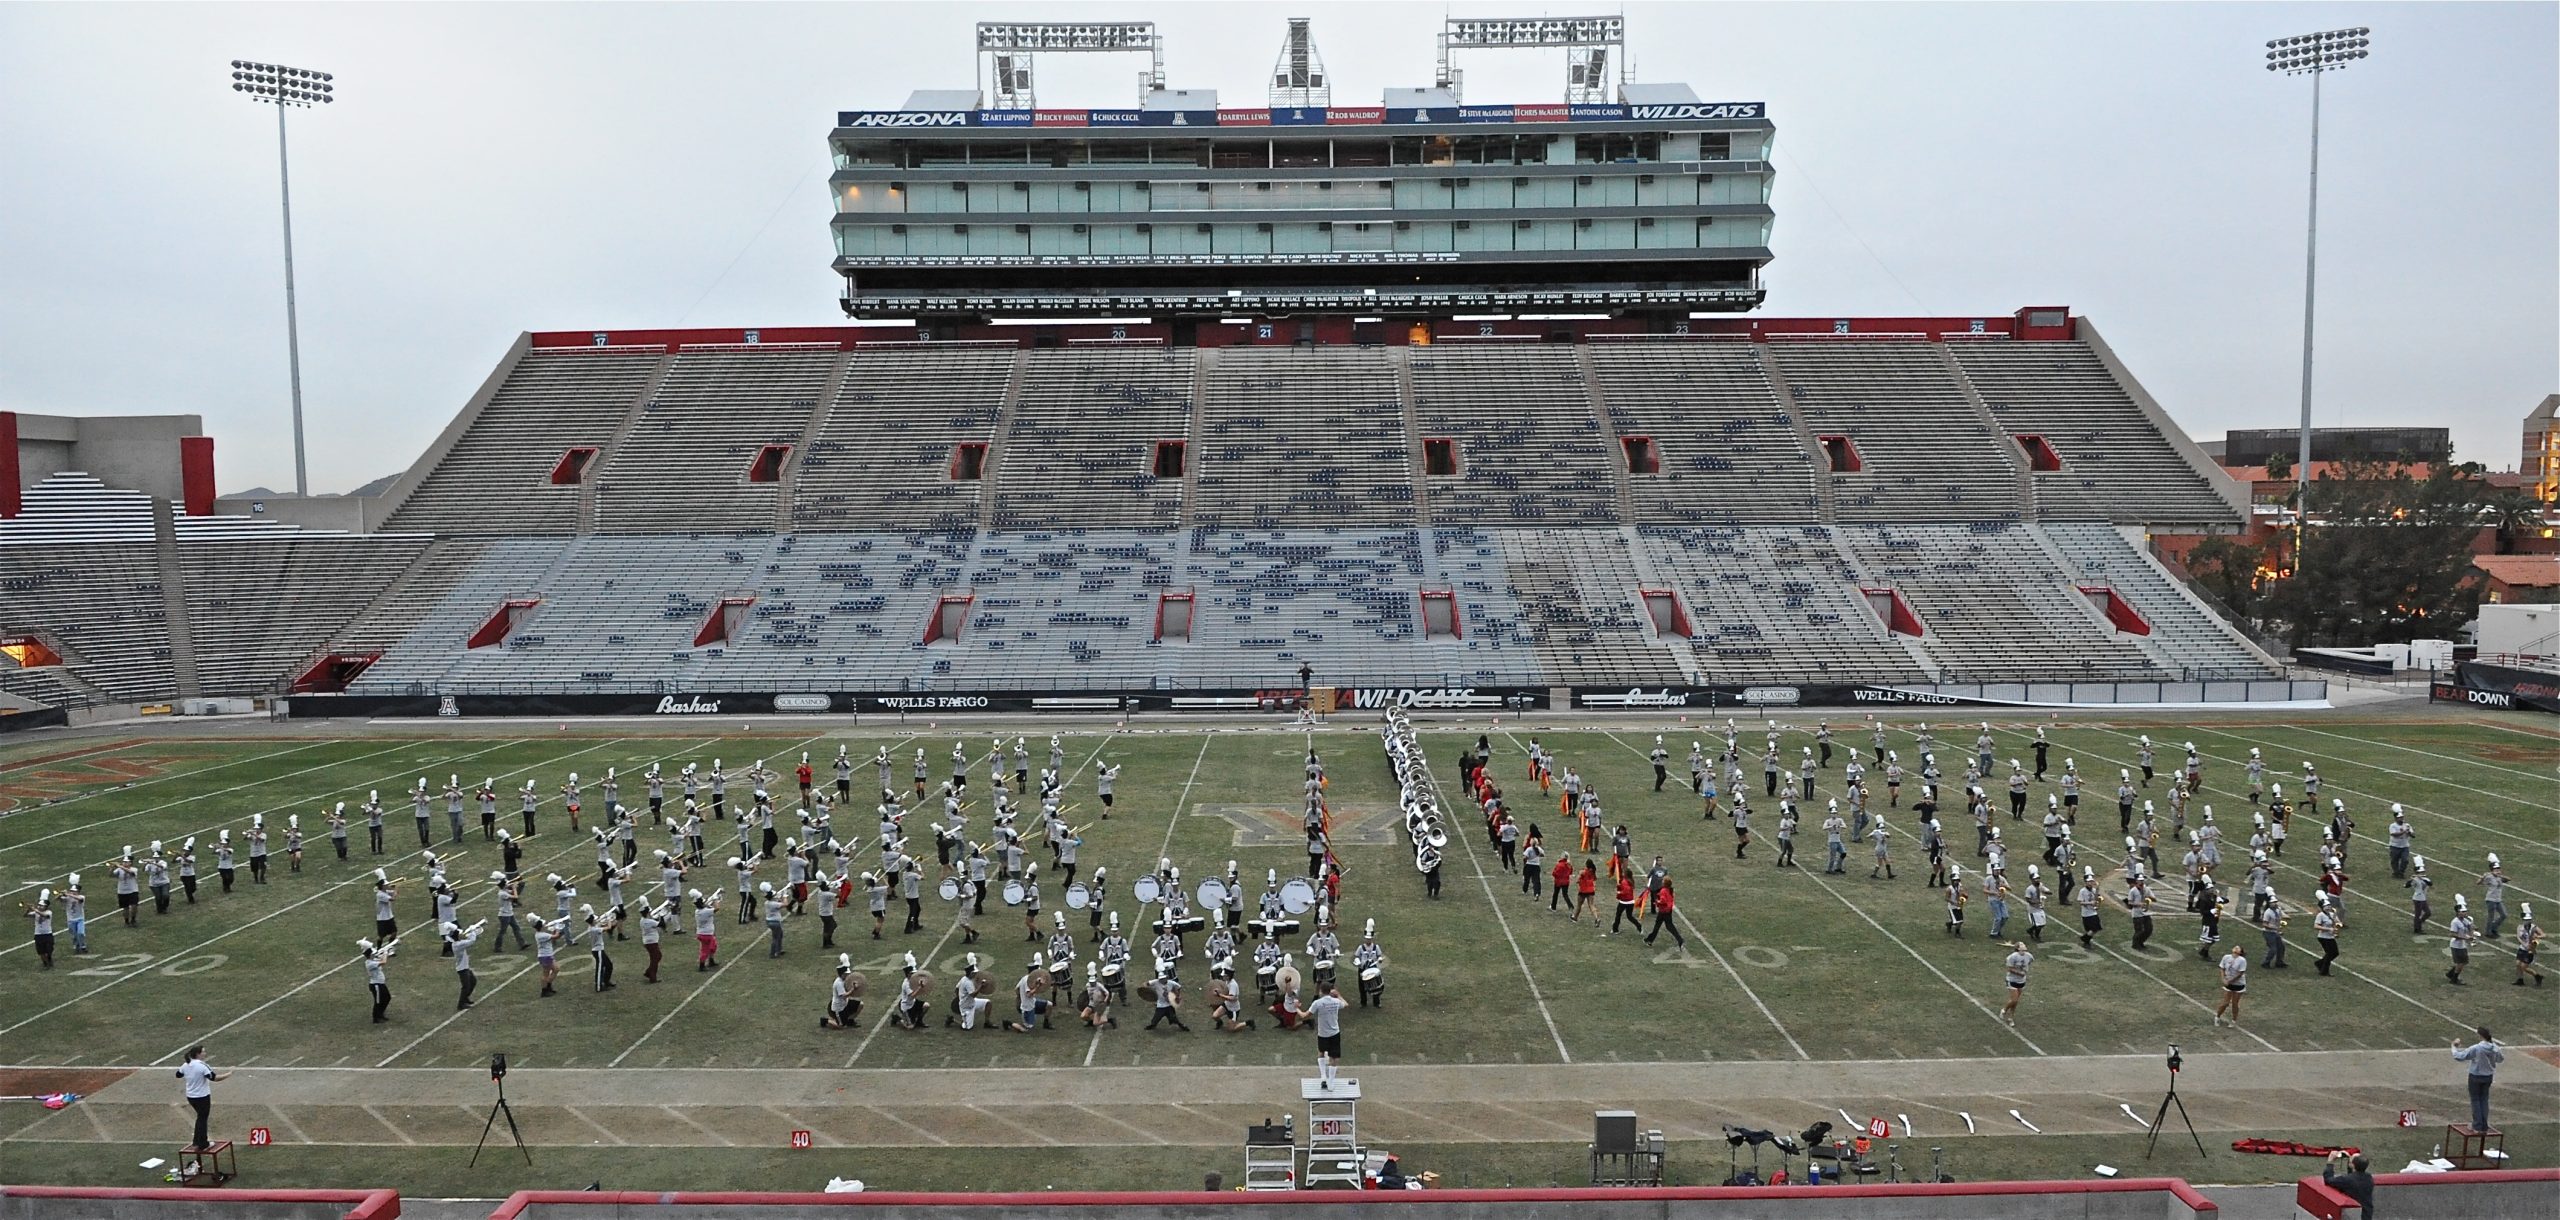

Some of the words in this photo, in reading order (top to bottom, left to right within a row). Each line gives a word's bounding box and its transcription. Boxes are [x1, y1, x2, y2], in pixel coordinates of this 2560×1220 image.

[1217, 112, 1222, 121] 4
[1222, 113, 1250, 122] DARRYLL
[1250, 113, 1270, 121] LEWIS
[1350, 112, 1380, 120] WALDROP
[1468, 110, 1480, 118] STEVE
[1514, 108, 1520, 116] 11
[1538, 108, 1568, 116] McALISTER
[1631, 105, 1757, 119] WILDCATS
[851, 113, 966, 126] ARIZONA
[981, 114, 989, 122] 22
[1003, 114, 1030, 122] LUPPINO
[1043, 114, 1060, 122] RICKY
[1062, 114, 1088, 122] HUNLEY
[1098, 114, 1120, 122] CHUCK
[1260, 328, 1271, 338] 21
[1480, 327, 1492, 336] 22
[1676, 326, 1688, 334] 23
[1836, 325, 1848, 333] 24
[1972, 324, 1984, 332] 25
[746, 335, 758, 344] 18
[919, 332, 930, 342] 19
[1112, 330, 1126, 339] 20
[596, 338, 606, 346] 17
[253, 504, 263, 512] 16
[1854, 690, 1904, 701] WELLS
[2436, 686, 2468, 700] BEAR
[2469, 690, 2509, 706] DOWN
[438, 696, 460, 716] A
[656, 695, 720, 714] Bashas'
[884, 698, 935, 708] WELLS
[938, 696, 988, 707] FARGO
[2036, 940, 2185, 963] 30
[66, 953, 229, 976] 20
[2402, 1111, 2416, 1126] 30
[1324, 1120, 1339, 1135] 50
[1871, 1120, 1885, 1136] 40
[252, 1130, 266, 1145] 30
[793, 1132, 808, 1146] 40
